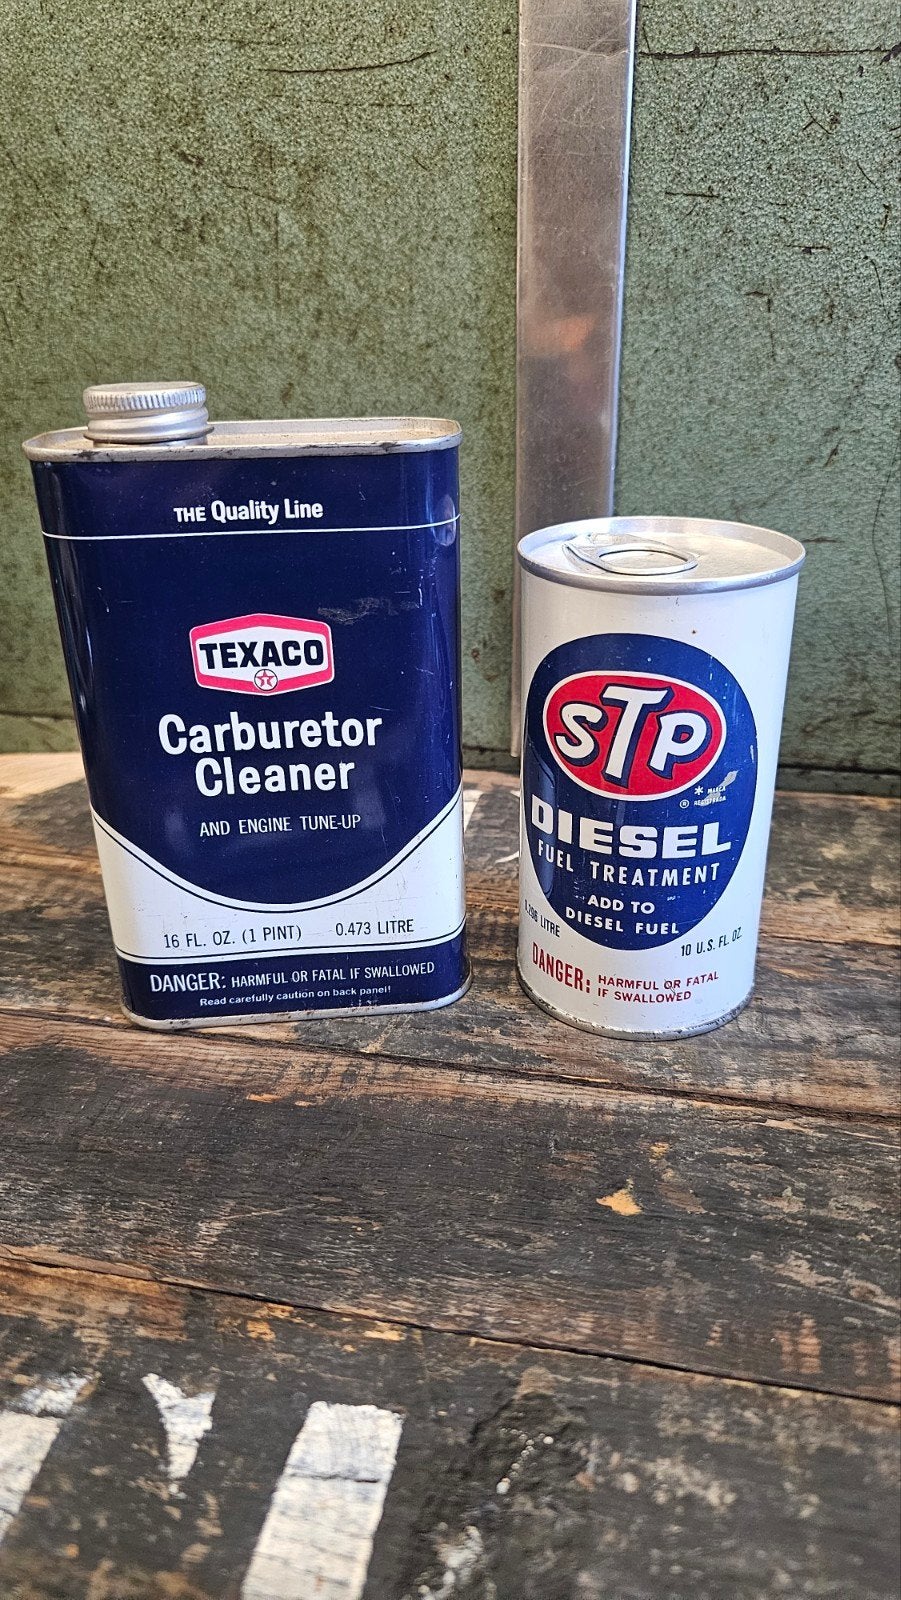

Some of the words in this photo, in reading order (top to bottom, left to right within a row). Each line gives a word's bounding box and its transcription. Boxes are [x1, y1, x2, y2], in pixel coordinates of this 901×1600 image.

[173, 507, 207, 522] THE
[211, 499, 279, 525] Quality
[284, 498, 323, 519] Line
[199, 639, 324, 669] TEXACO
[158, 711, 382, 755] Carburetor
[553, 682, 713, 788] STP
[195, 757, 355, 797] Cleaner
[200, 820, 230, 837] AND
[238, 816, 292, 834] ENGINE
[300, 813, 361, 831] TUNE-UP
[531, 794, 731, 859] DIESEL
[538, 839, 574, 873] FUEL
[590, 861, 720, 887] TREATMENT
[587, 894, 624, 911] ADD
[631, 901, 655, 914] TO
[335, 921, 371, 937] 0.473
[377, 919, 414, 934] LITRE
[540, 915, 560, 938] LITRE
[565, 907, 624, 933] DIESEL
[635, 922, 679, 935] FUEL
[164, 934, 180, 948] 16
[186, 933, 207, 947] FL.
[212, 930, 236, 946] OZ.
[242, 928, 256, 944] (1
[263, 925, 302, 941] PINT)
[681, 943, 692, 956] 10
[718, 934, 729, 948] FL.
[150, 972, 227, 993] DANGER:
[231, 972, 288, 988] HARMFUL
[291, 970, 308, 983] OR
[312, 969, 347, 982] FATAL
[350, 967, 361, 980] IF
[364, 961, 435, 979] SWALLOWED
[532, 941, 591, 994] DANGER:
[598, 974, 659, 990] HARMFUL
[664, 979, 681, 990] OR
[686, 971, 719, 987] FATAL
[200, 996, 226, 1007] Read
[229, 993, 274, 1005] carefully
[276, 989, 314, 1000] caution
[317, 989, 330, 997] on
[332, 987, 357, 996] back
[359, 985, 391, 996] panel!
[597, 987, 609, 998] IF
[614, 991, 692, 1003] SWALLOWED
